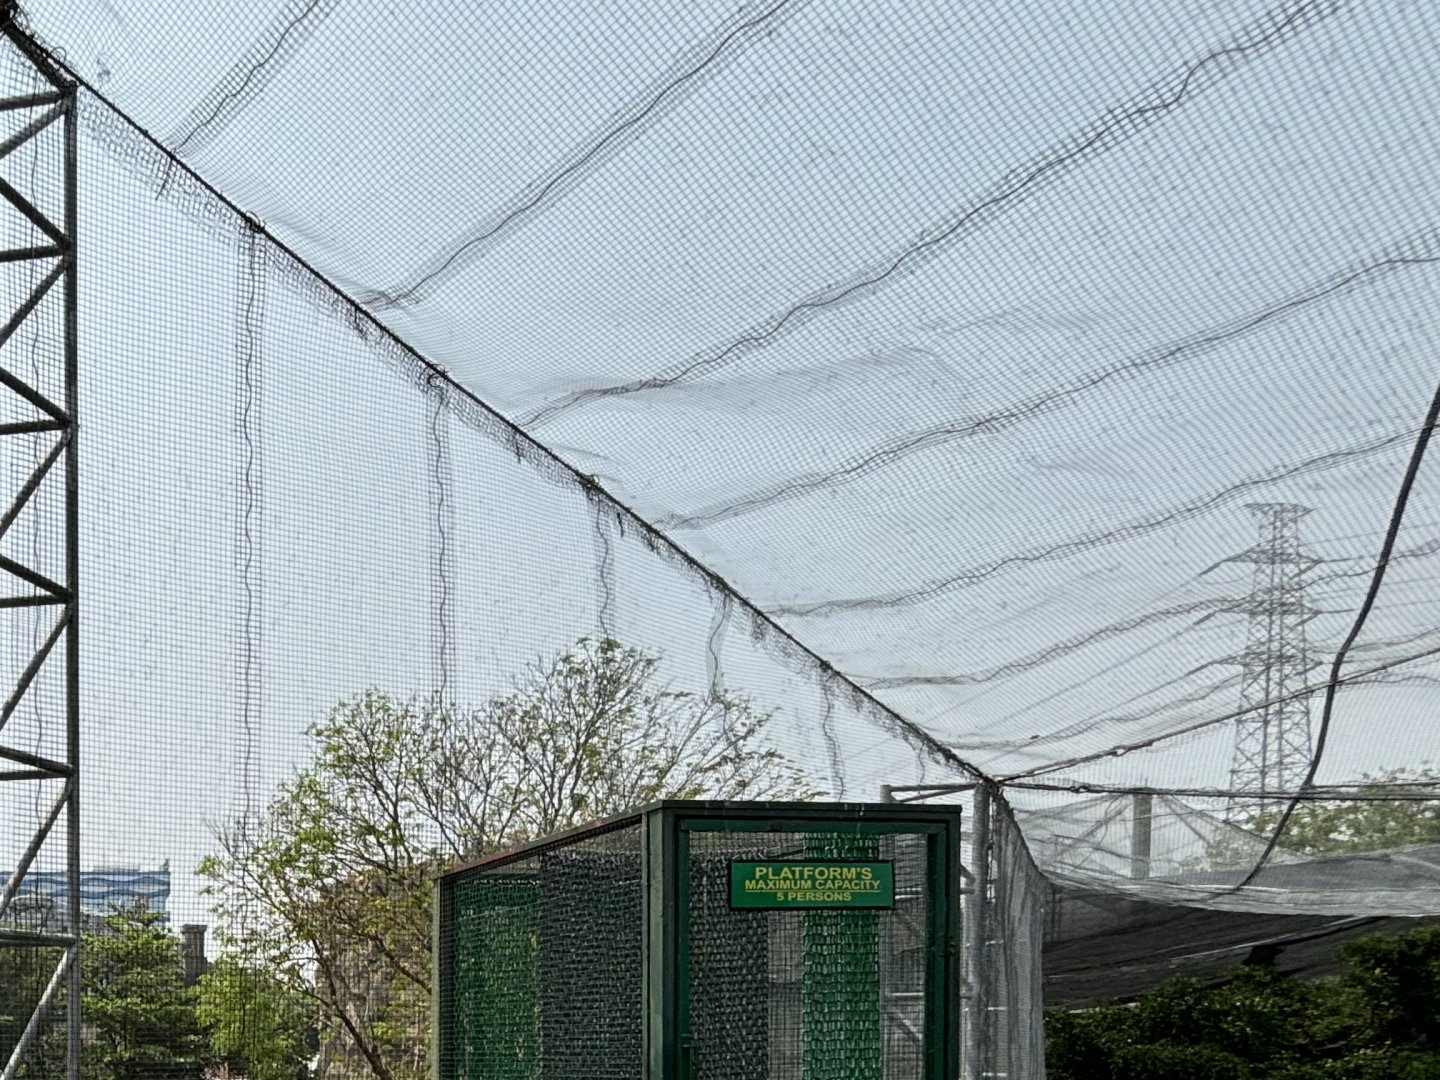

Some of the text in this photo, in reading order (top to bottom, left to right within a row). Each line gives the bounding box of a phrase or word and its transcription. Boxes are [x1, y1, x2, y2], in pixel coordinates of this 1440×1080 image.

[755, 866, 873, 880] PLATFORM'S
[745, 879, 881, 890] MAXIMUM CAPACITY
[776, 892, 852, 902] 5 PERSONS
